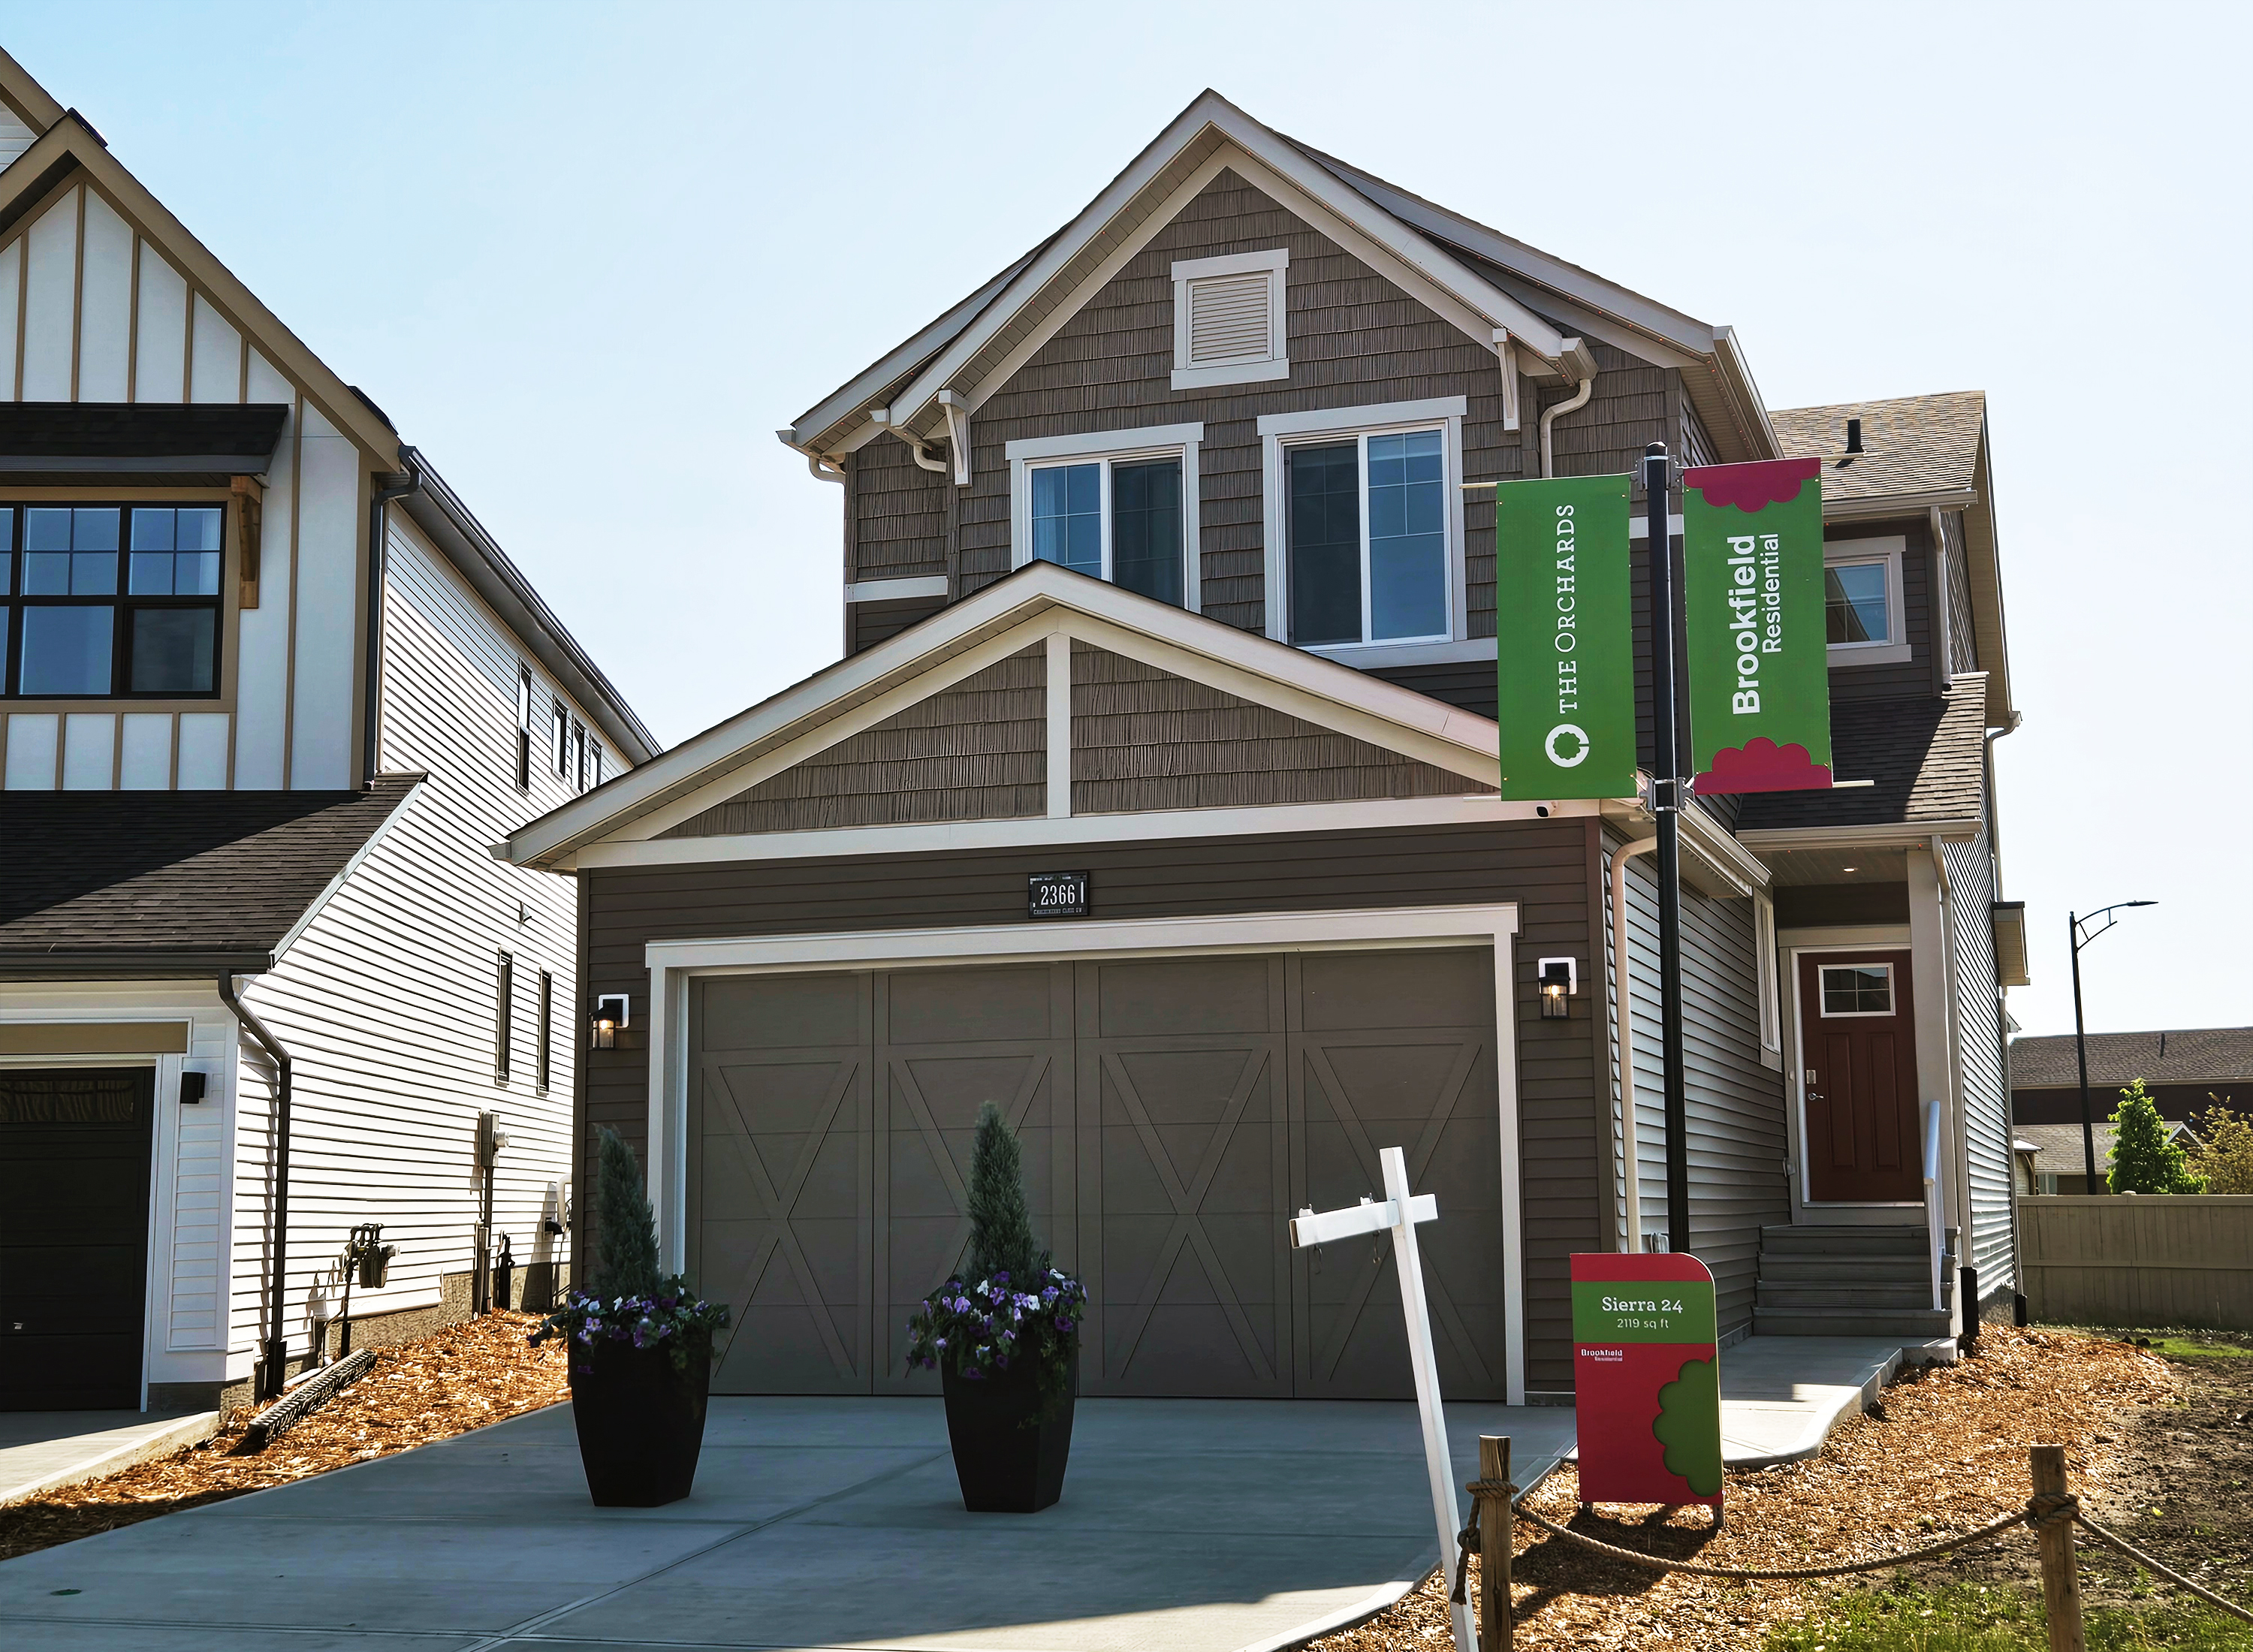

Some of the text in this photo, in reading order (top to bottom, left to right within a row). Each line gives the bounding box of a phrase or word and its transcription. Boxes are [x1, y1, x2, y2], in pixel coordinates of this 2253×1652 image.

[1555, 505, 1578, 714] THE ORCHARDS
[1727, 535, 1760, 715] Brookfield
[1759, 533, 1782, 653] Residential
[1602, 1296, 1683, 1314] Sierra 24
[1617, 1318, 1669, 1330] 2119 sq ft
